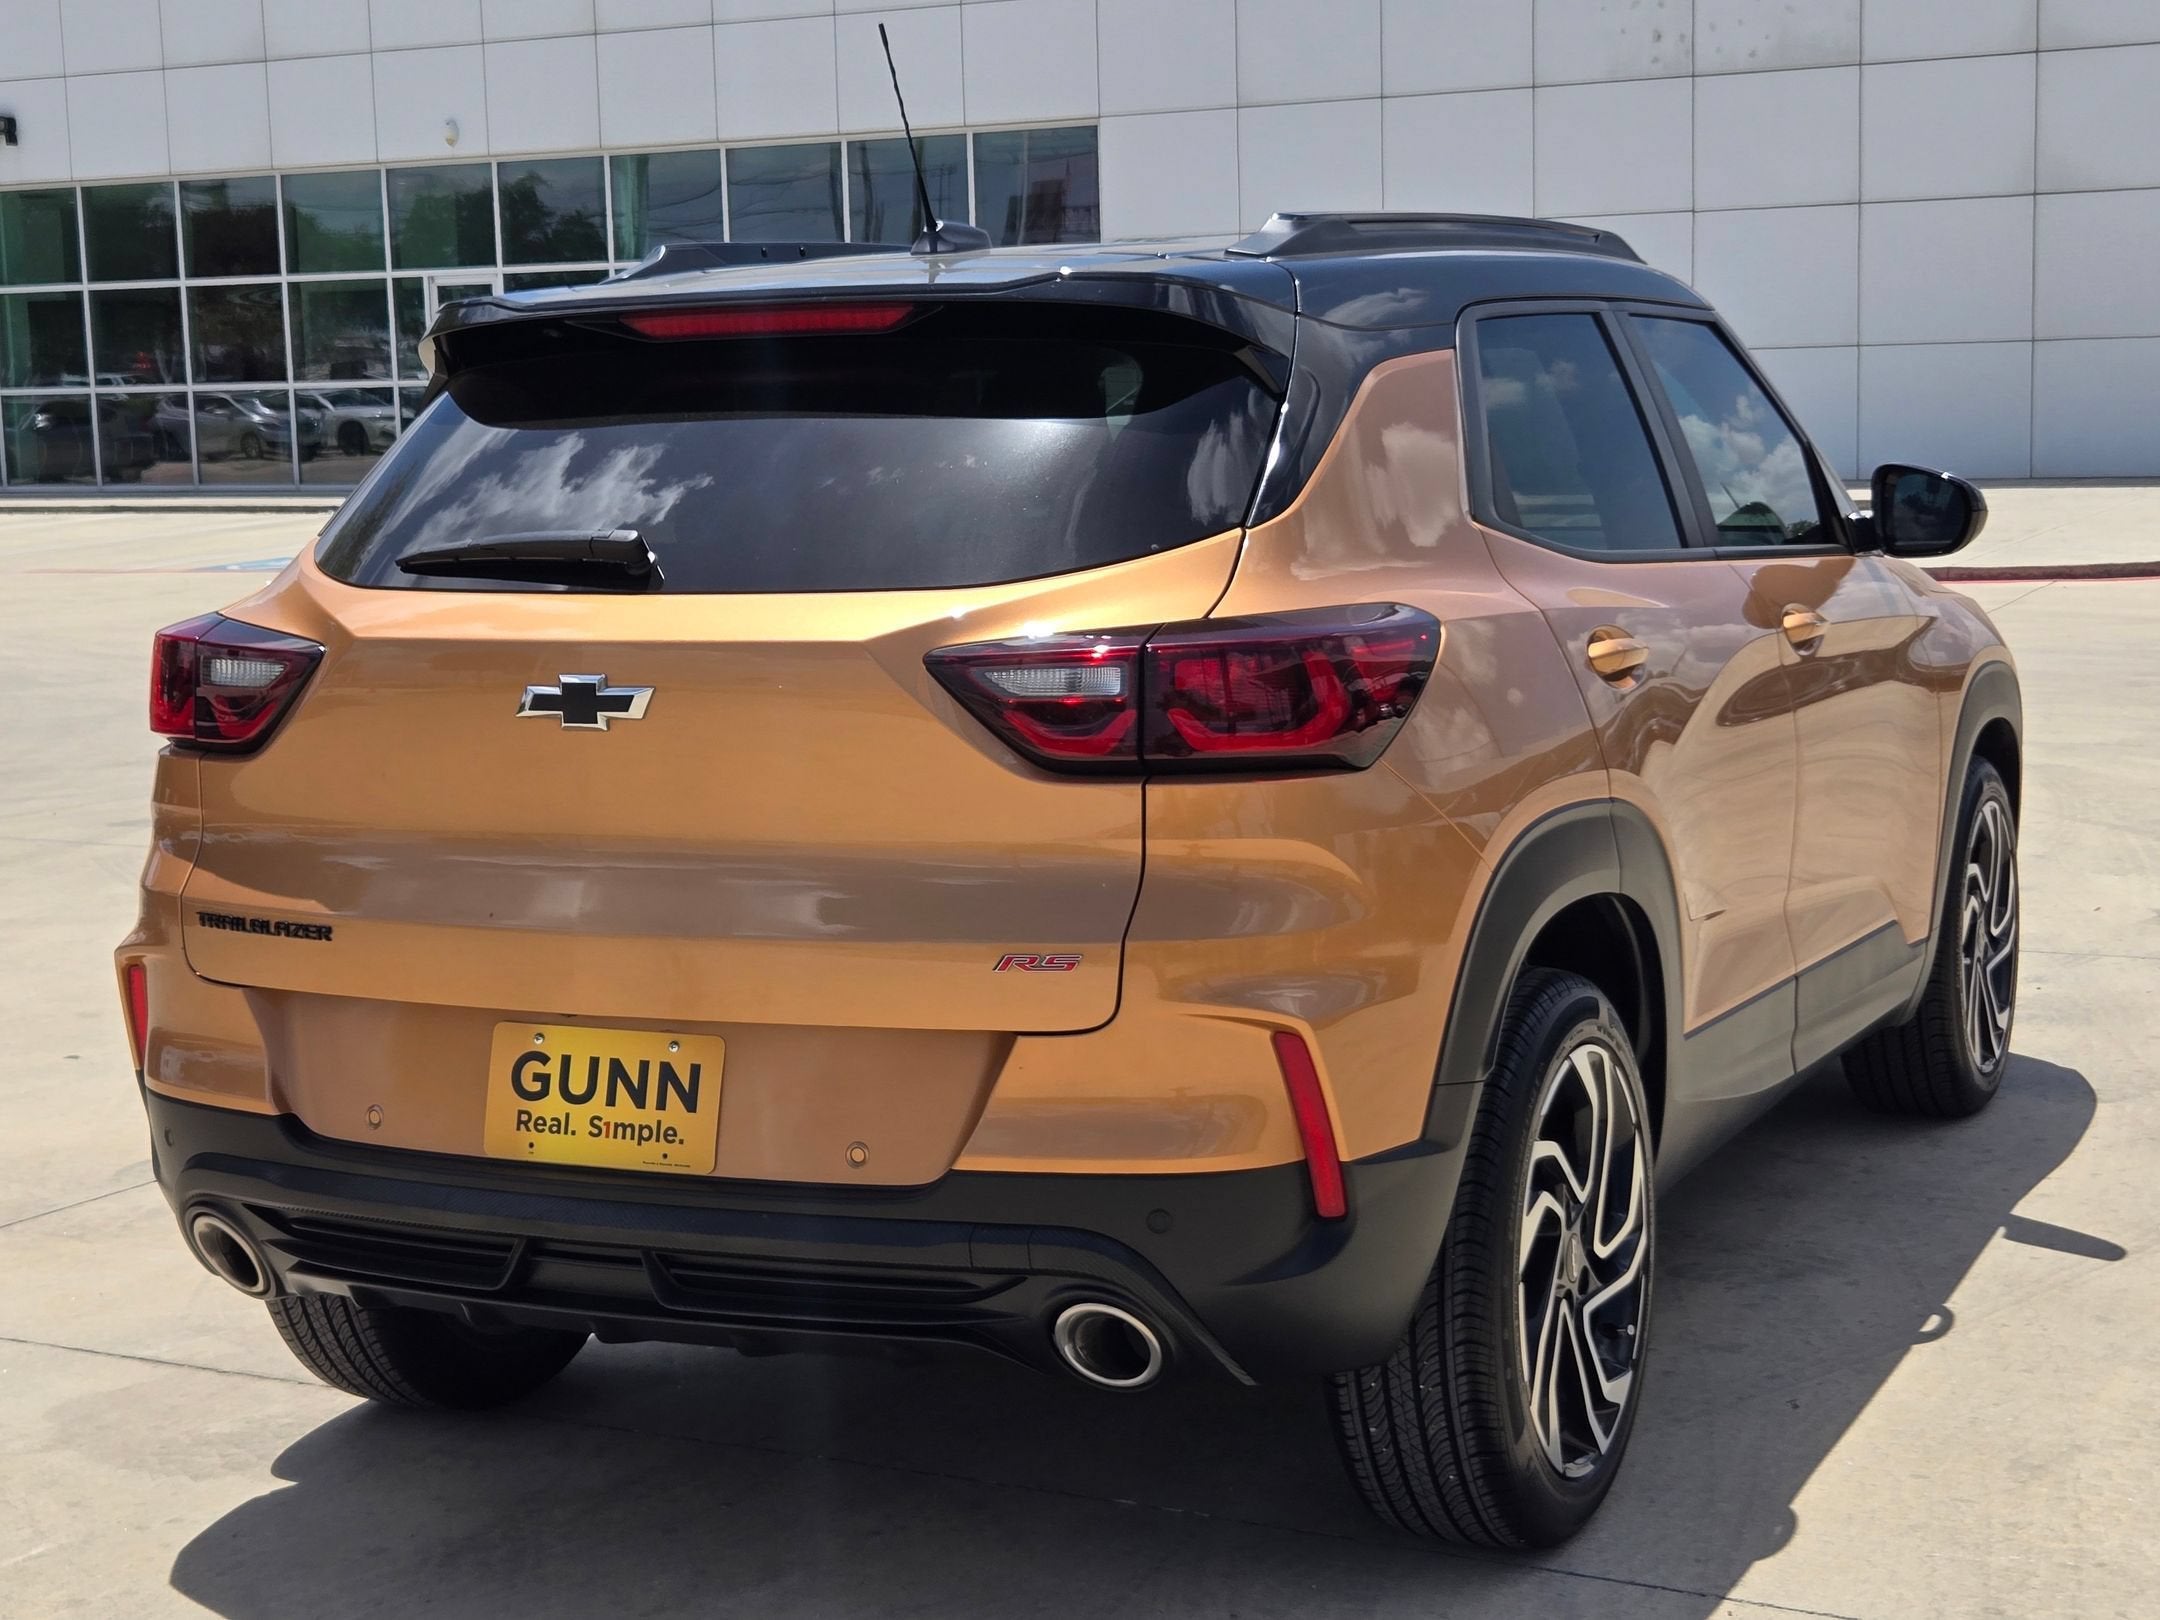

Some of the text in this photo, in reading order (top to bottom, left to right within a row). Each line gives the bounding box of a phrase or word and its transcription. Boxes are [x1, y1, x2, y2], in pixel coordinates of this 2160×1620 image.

[196, 912, 333, 941] TRAILBLAZER
[992, 953, 1083, 973] RS
[511, 1050, 702, 1114] GUNN
[516, 1109, 577, 1136] Real.
